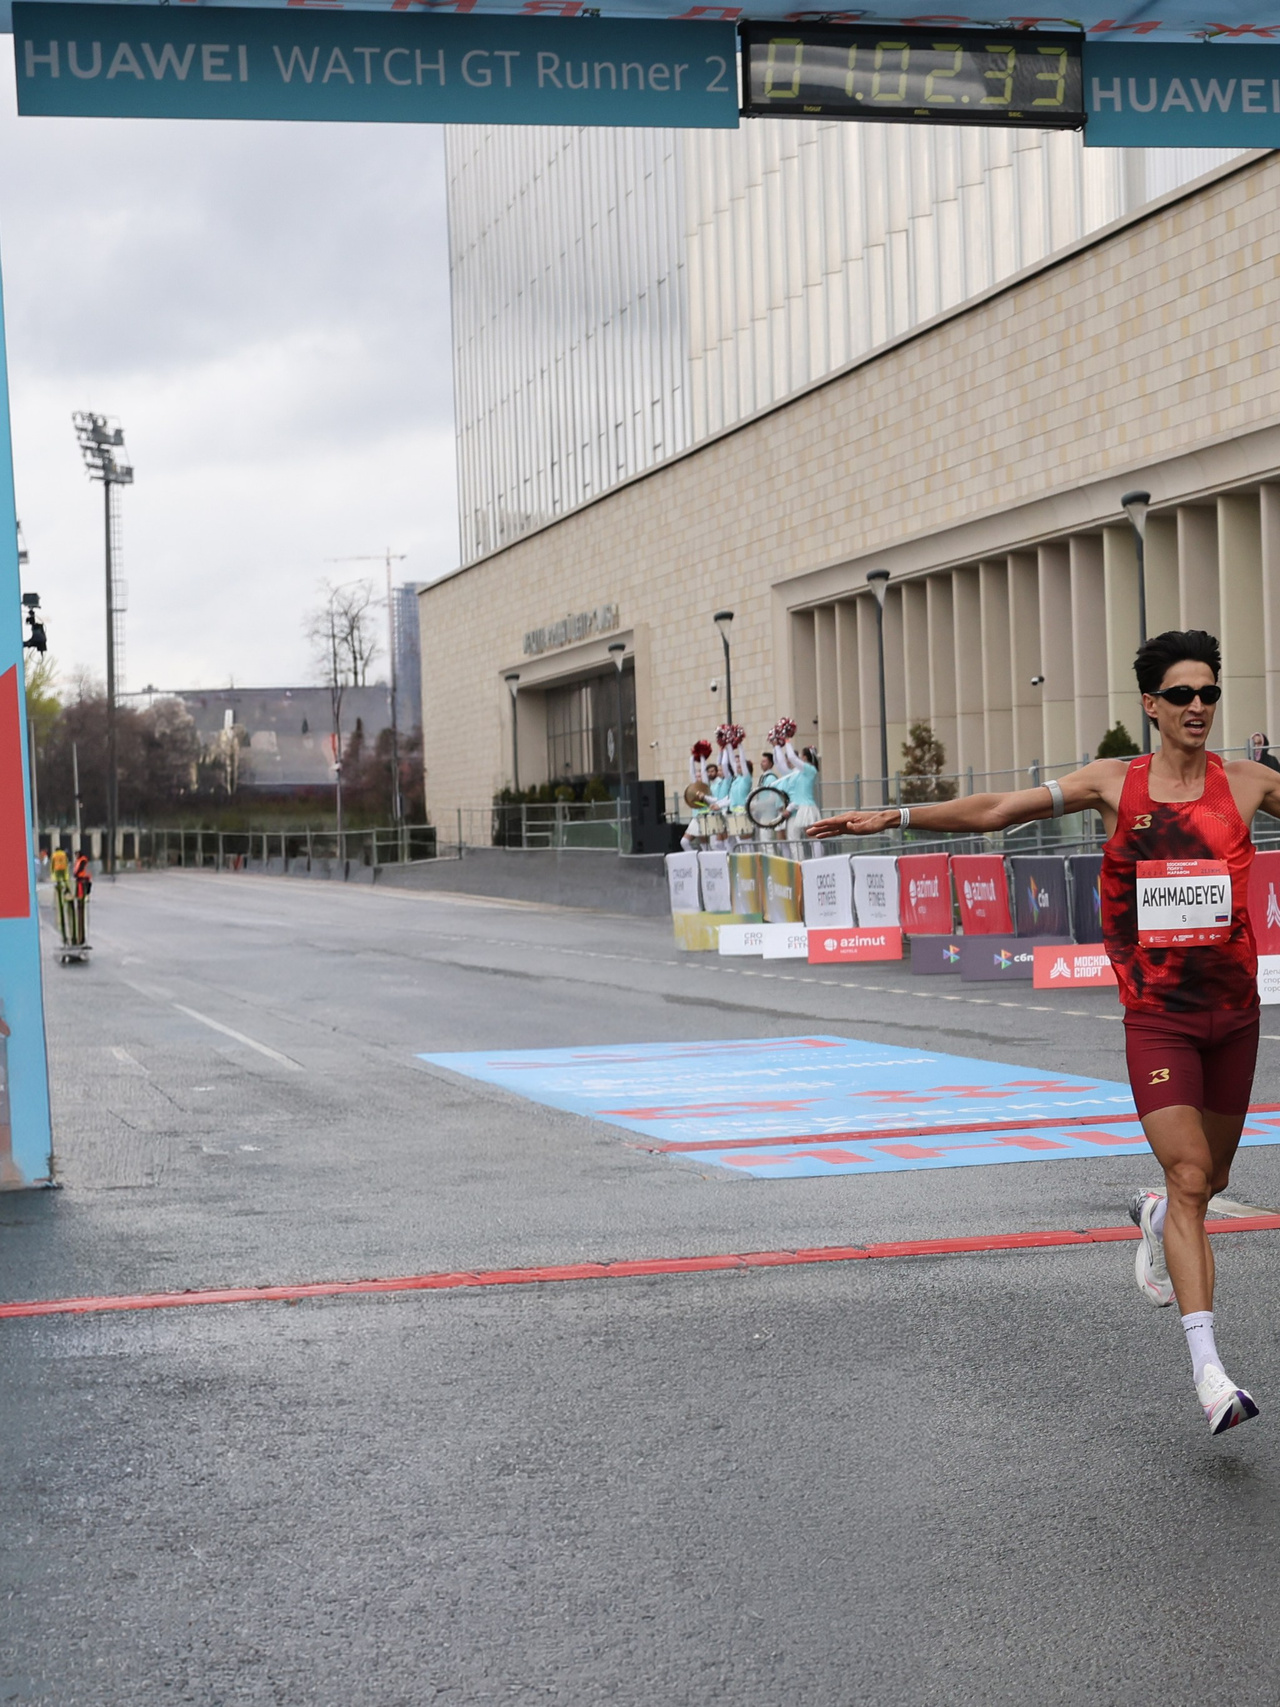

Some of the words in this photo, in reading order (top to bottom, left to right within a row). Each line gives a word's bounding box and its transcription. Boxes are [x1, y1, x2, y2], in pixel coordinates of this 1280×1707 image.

[25, 40, 249, 83] HUAWEI
[273, 46, 446, 86] WATCH
[461, 50, 520, 88] GT
[537, 52, 689, 92] Runner
[705, 55, 729, 92] 2
[1092, 77, 1280, 113] HUAWEI
[917, 874, 939, 898] azimut
[971, 875, 996, 902] azimut
[1142, 884, 1225, 907] AKHMADEYEV
[1181, 914, 1187, 922] 5
[840, 935, 886, 948] azimut
[1074, 966, 1102, 978] СПОРТ
